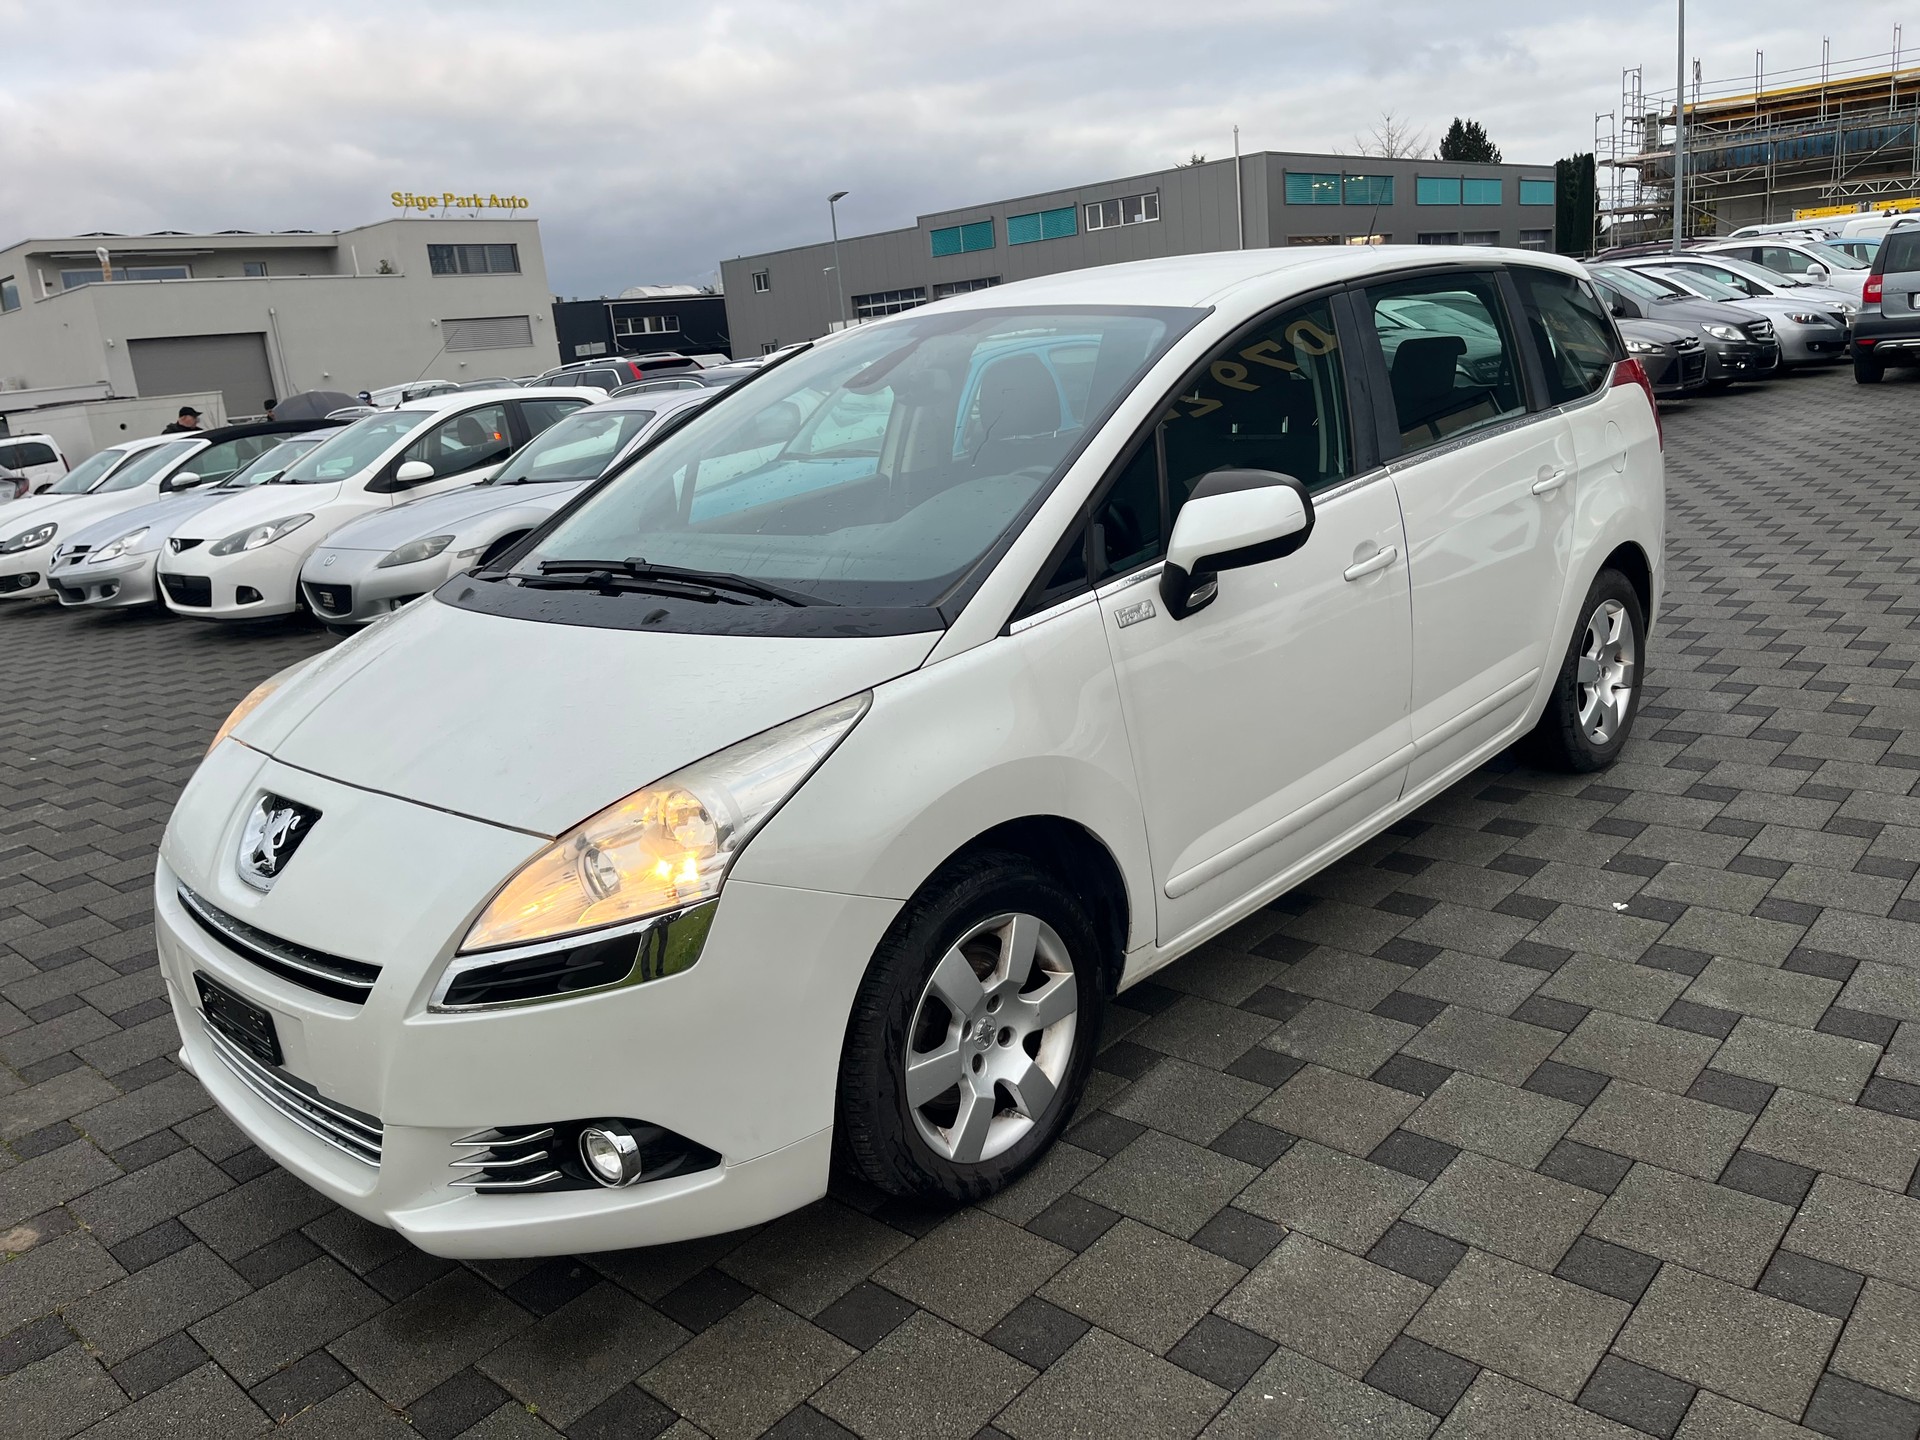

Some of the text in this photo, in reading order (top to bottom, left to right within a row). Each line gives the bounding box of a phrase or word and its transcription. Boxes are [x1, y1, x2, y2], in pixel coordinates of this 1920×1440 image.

[391, 192, 529, 210] Säge Park Auto
